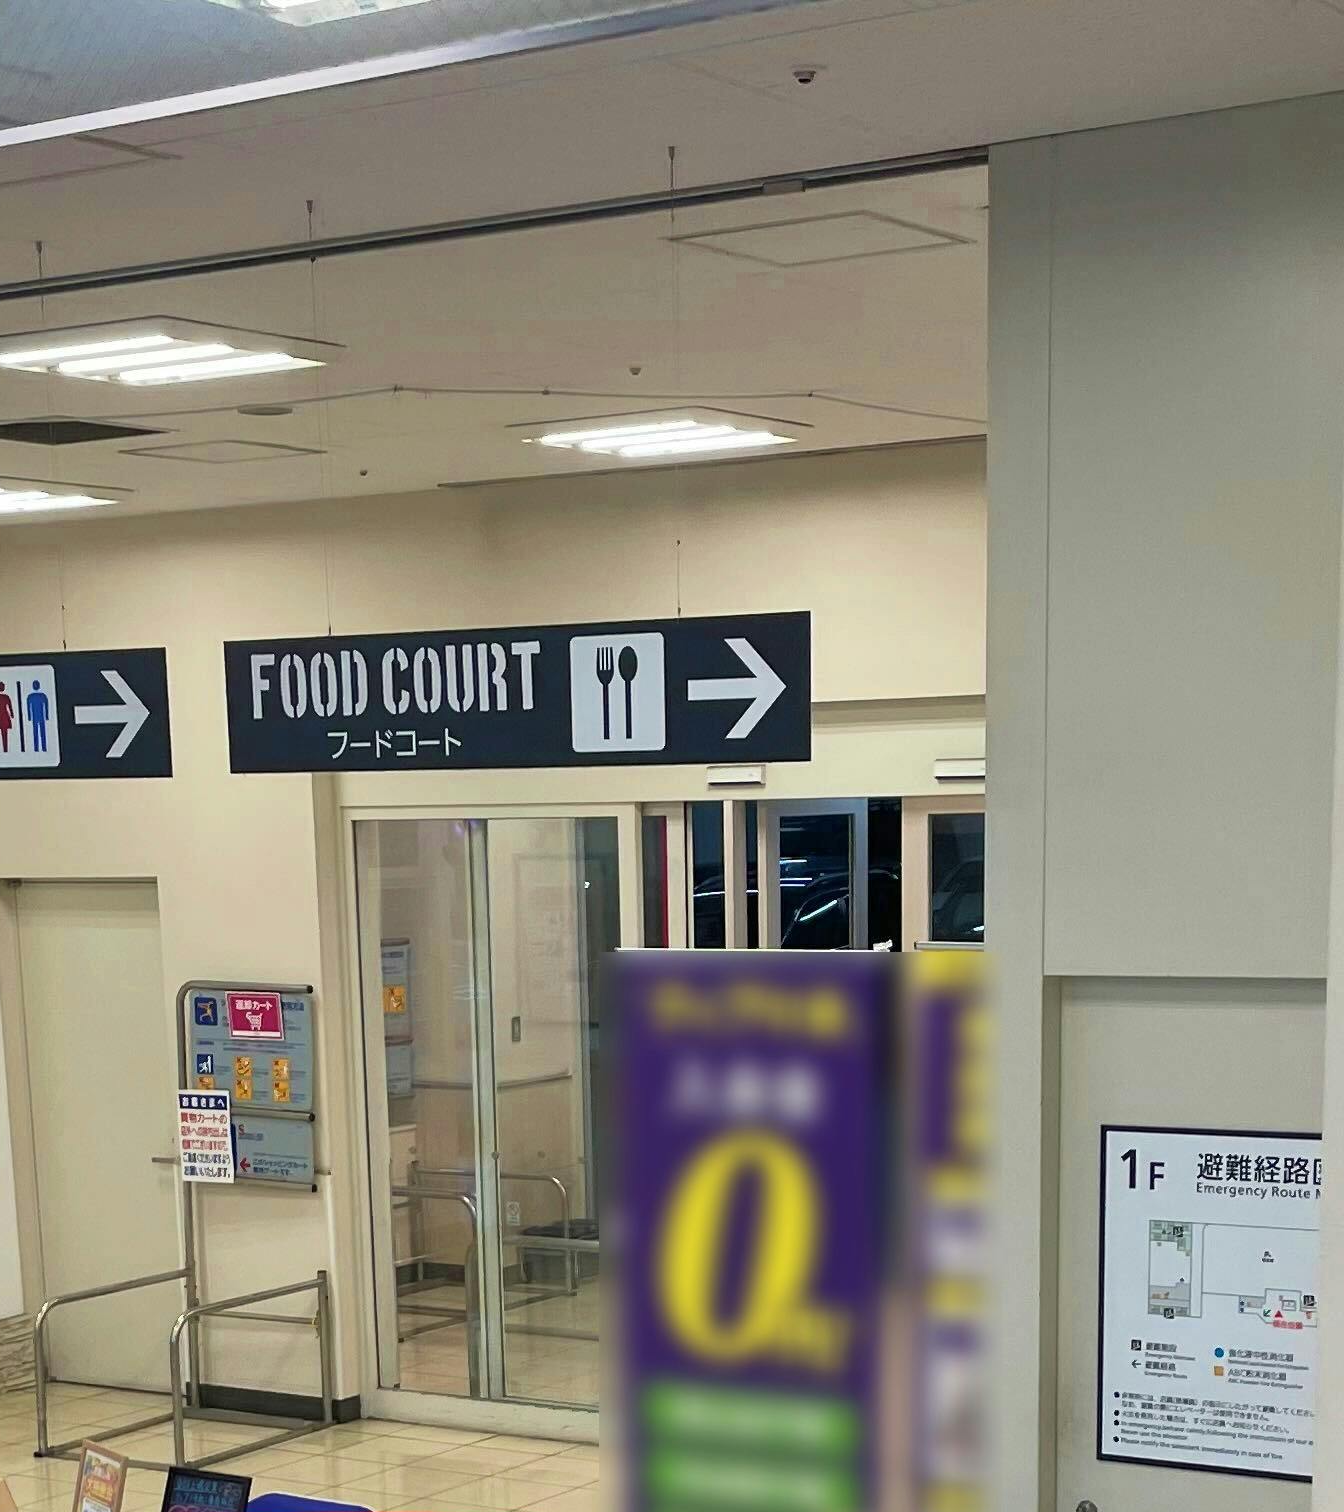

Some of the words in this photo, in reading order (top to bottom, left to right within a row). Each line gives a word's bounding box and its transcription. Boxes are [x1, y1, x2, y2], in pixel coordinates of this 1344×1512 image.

[251, 650, 368, 719] FOOD
[381, 641, 541, 715] COURT
[327, 728, 462, 758] フードコート
[1121, 1149, 1165, 1190] 1F
[1196, 1182, 1267, 1199] Emergency
[1271, 1186, 1310, 1199] Route
